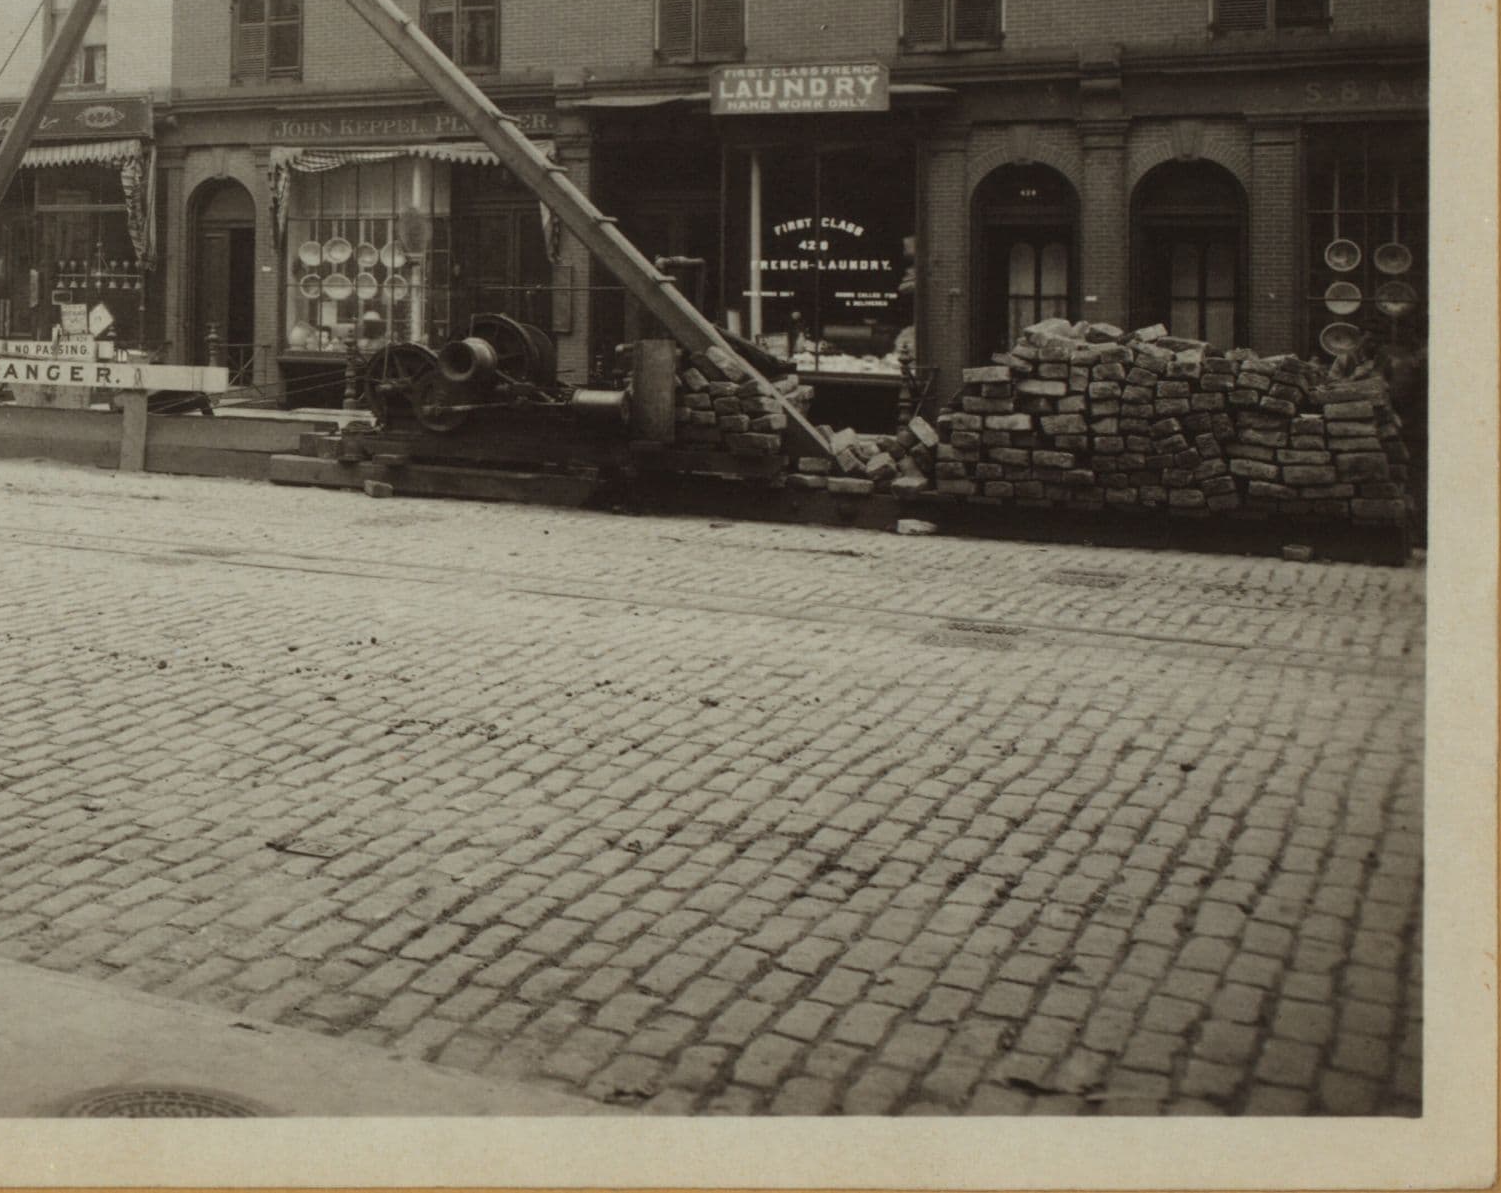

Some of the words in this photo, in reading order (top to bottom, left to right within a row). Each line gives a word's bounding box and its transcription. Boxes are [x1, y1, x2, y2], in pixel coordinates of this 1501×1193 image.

[724, 68, 765, 79] FIRST
[772, 67, 819, 77] CLASS
[822, 65, 880, 76] FRENCH
[719, 75, 879, 100] LAUNDRY
[728, 100, 771, 111] HAND
[776, 99, 825, 109] WORK
[275, 119, 332, 137] JOHN
[435, 112, 556, 132] PLER.
[773, 218, 812, 236] FIRST
[820, 217, 865, 236] CLASS
[14, 345, 30, 355] NO
